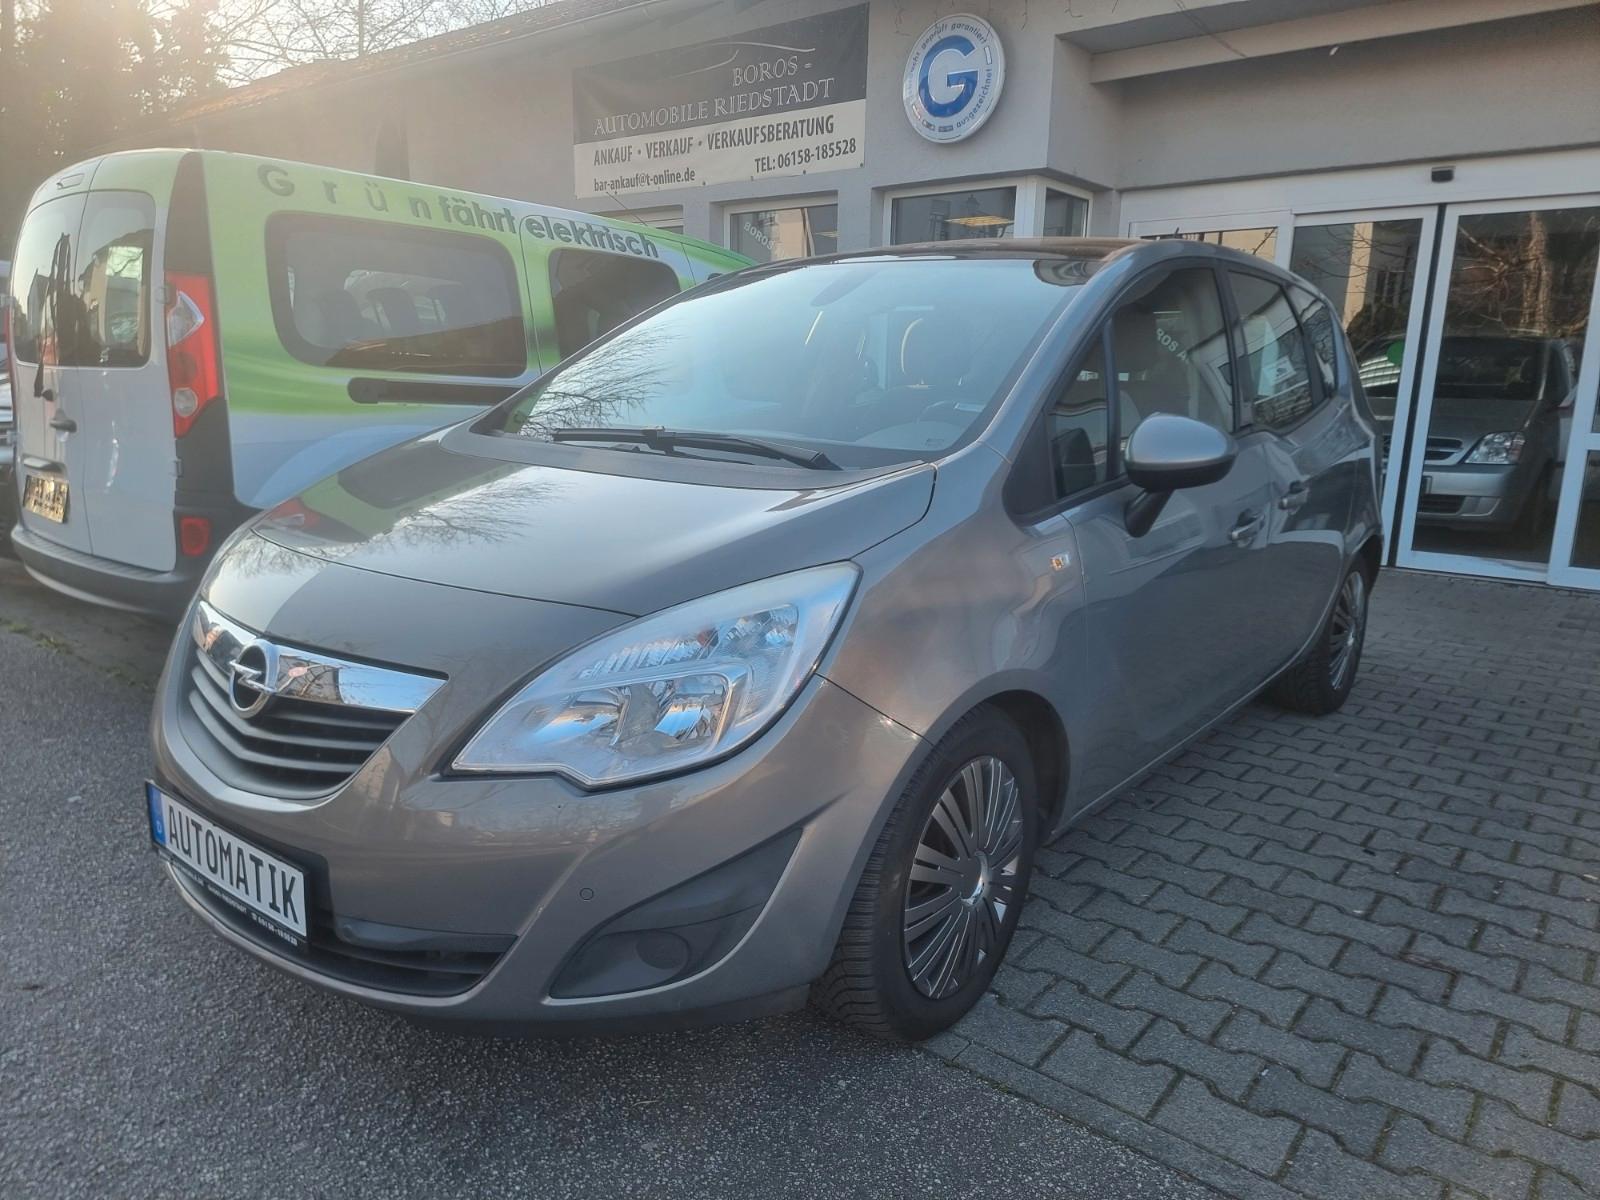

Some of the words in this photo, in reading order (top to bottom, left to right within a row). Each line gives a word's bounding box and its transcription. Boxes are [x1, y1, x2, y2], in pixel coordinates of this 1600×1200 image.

[951, 22, 987, 45] garantiert
[733, 56, 798, 87] BOROS
[918, 34, 979, 118] G
[594, 100, 708, 136] AUTOMOBILE
[714, 77, 835, 117] RIEDSTADT
[956, 68, 993, 128] ausgezeichnet
[593, 145, 633, 166] ANKAUF
[645, 136, 694, 159] VERKAUF
[707, 114, 834, 150] VERKAUFSBERATUNG
[755, 157, 776, 173] TEL:
[777, 137, 857, 169] 06158-185528
[593, 167, 696, 191] bar-ankauf@t-online.de
[257, 163, 432, 221] Grün
[439, 194, 517, 235] fährt
[525, 213, 659, 259] elektrisch
[743, 221, 775, 250] BOROS
[168, 804, 300, 925] AUTOMATIK
